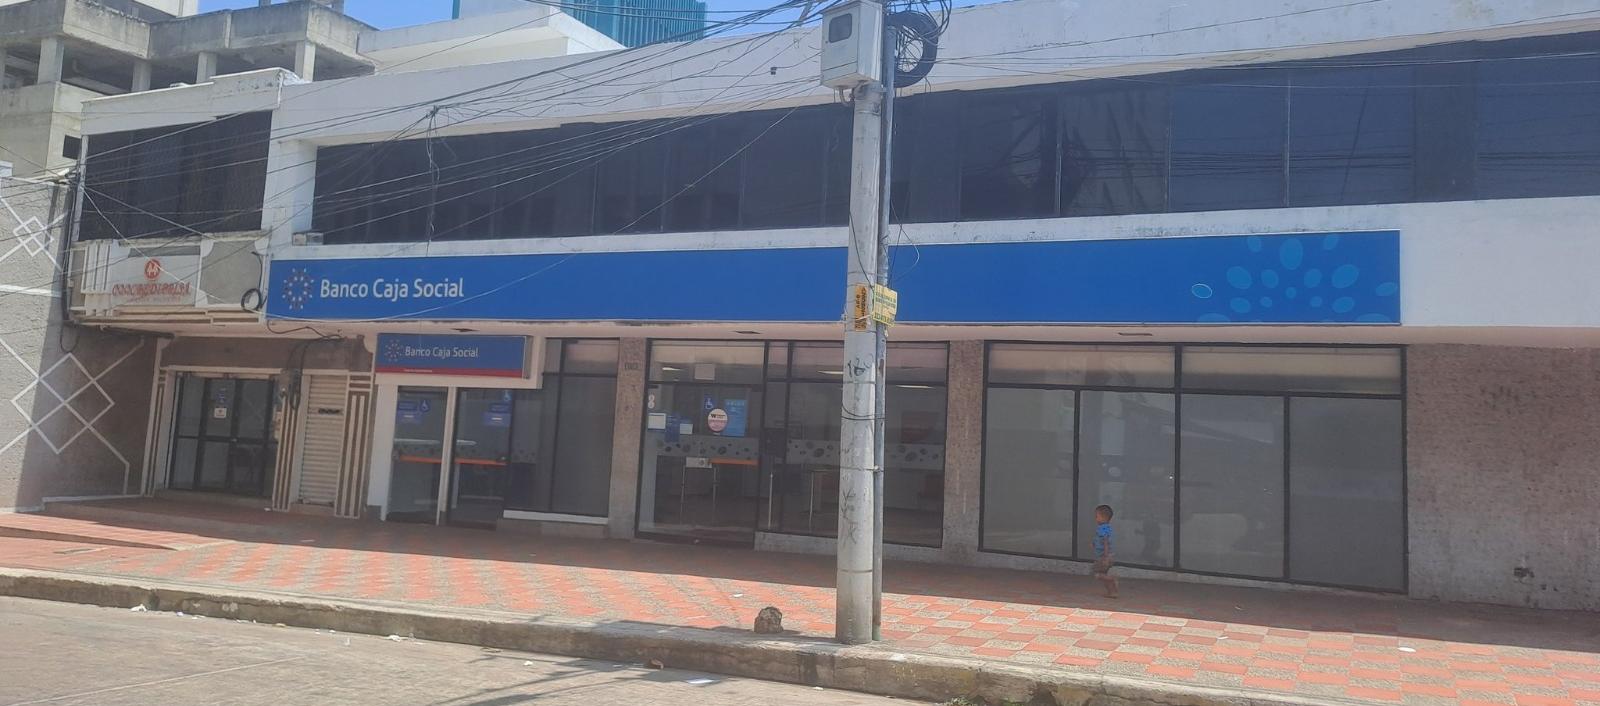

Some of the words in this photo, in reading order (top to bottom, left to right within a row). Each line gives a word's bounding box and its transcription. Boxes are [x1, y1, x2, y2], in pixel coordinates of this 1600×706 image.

[320, 279, 369, 298] Banco
[373, 280, 408, 301] Caja
[412, 277, 465, 298] Social
[405, 346, 431, 357] Banco
[432, 346, 451, 359] Caja
[452, 346, 479, 358] Social
